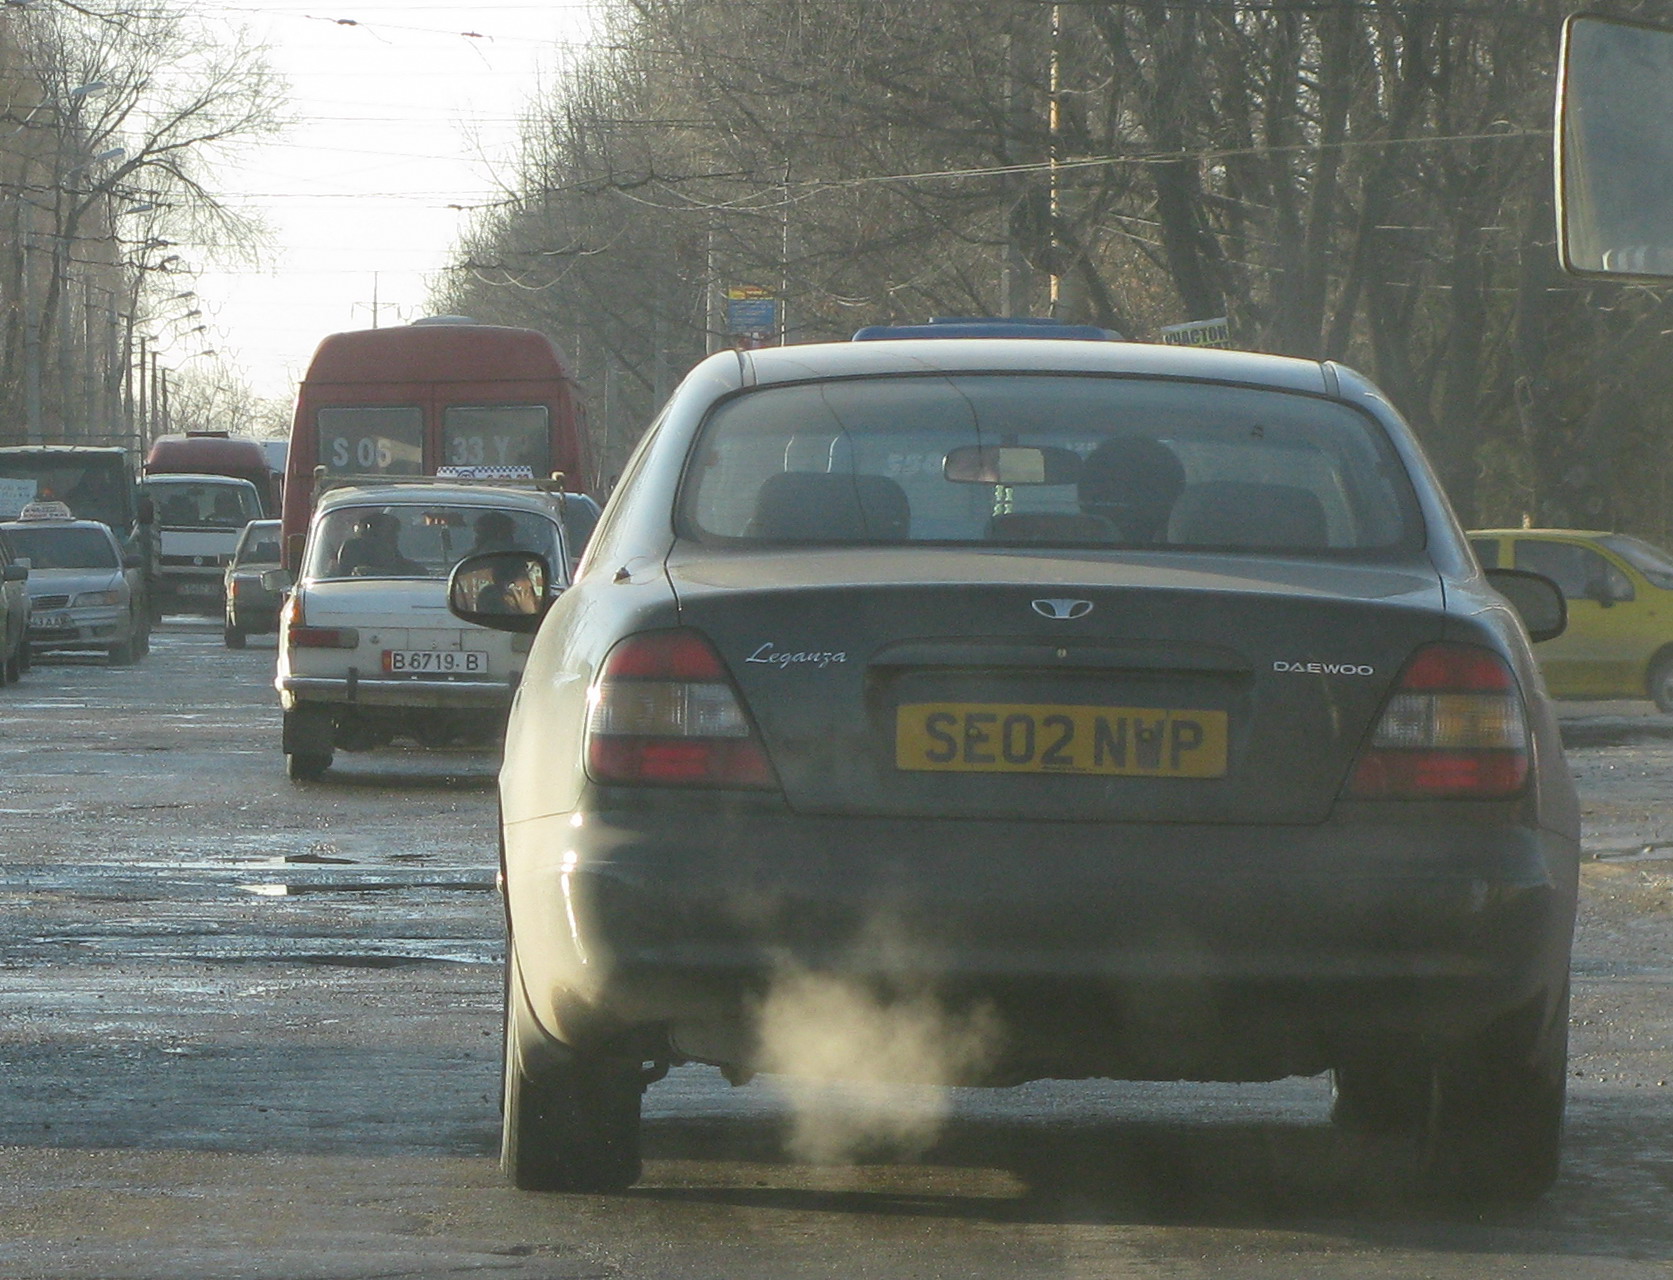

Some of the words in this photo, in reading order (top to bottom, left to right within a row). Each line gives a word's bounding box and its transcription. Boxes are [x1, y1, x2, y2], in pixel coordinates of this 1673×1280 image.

[332, 437, 349, 468] S
[745, 642, 847, 669] Leganza
[1273, 660, 1374, 676] DAEWOO
[925, 712, 1075, 766] SE02
